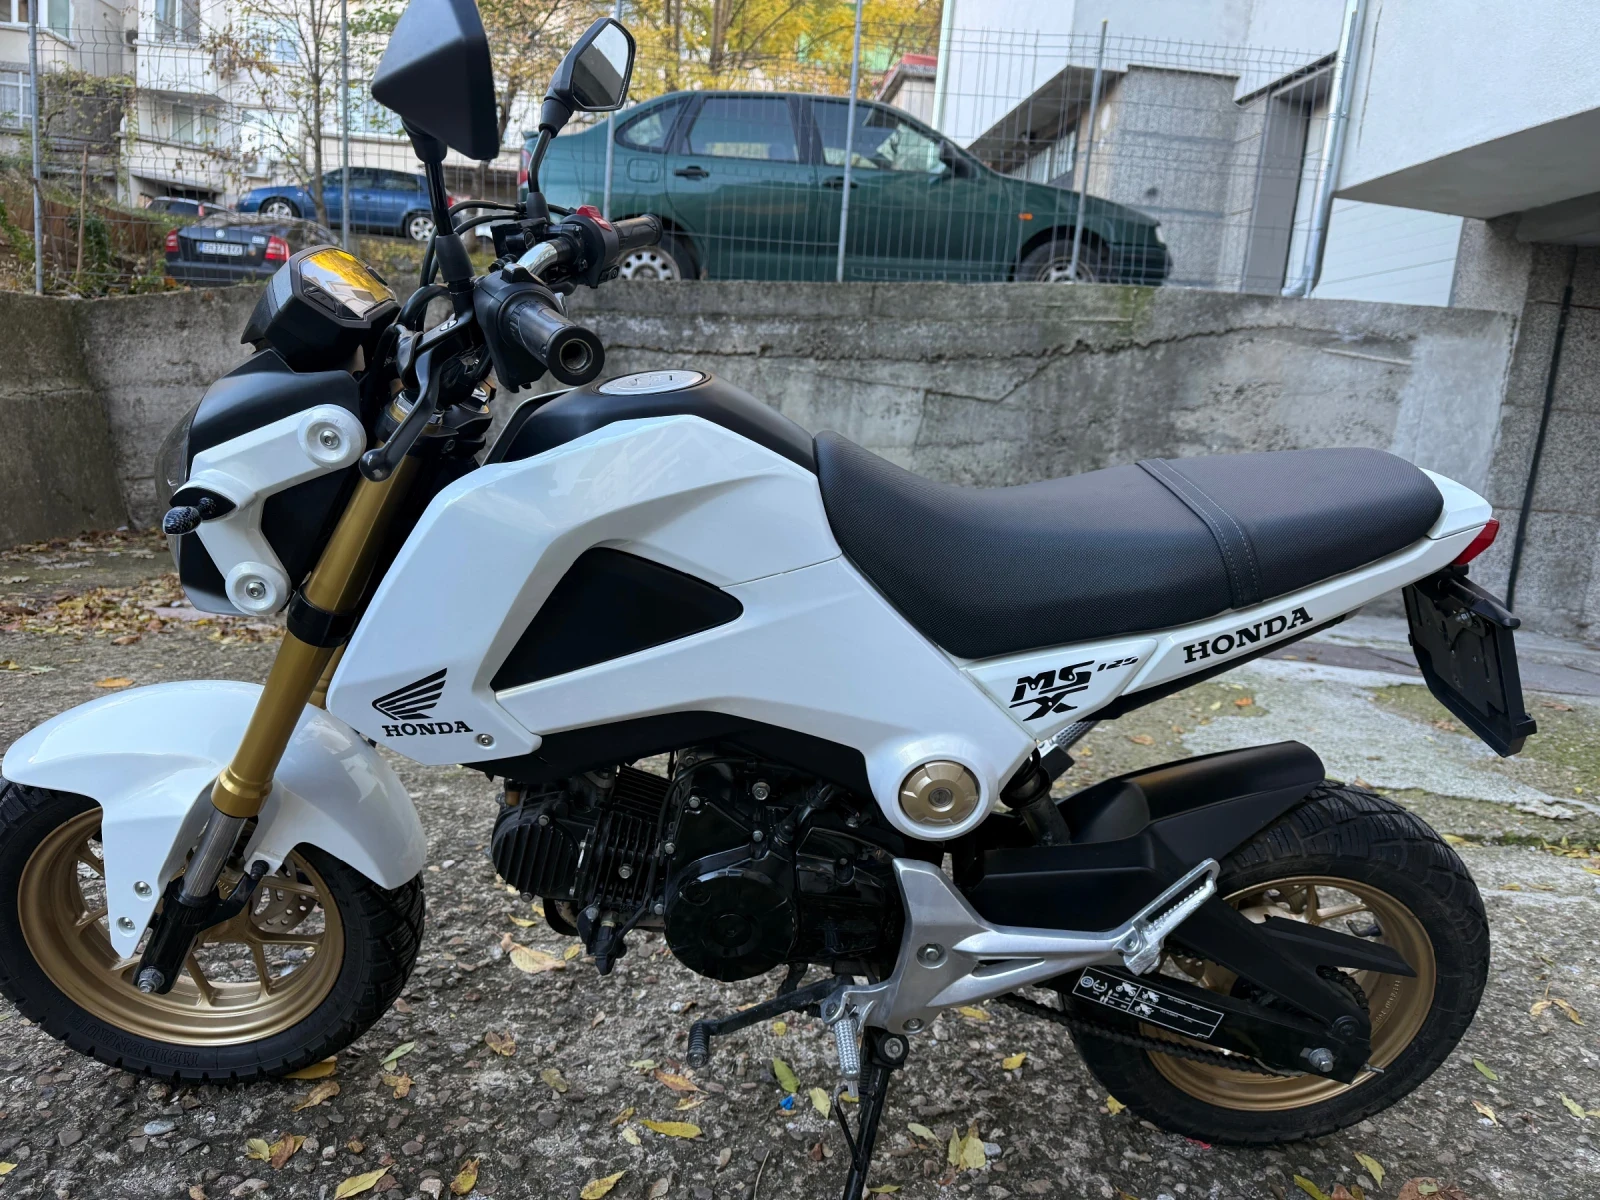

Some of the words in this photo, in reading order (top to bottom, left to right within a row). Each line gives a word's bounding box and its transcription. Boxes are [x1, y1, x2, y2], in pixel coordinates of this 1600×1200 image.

[1183, 606, 1313, 664] HONDA
[1097, 656, 1139, 672] 125
[381, 720, 473, 737] HONDA
[79, 1021, 199, 1067] HEIDENAU
